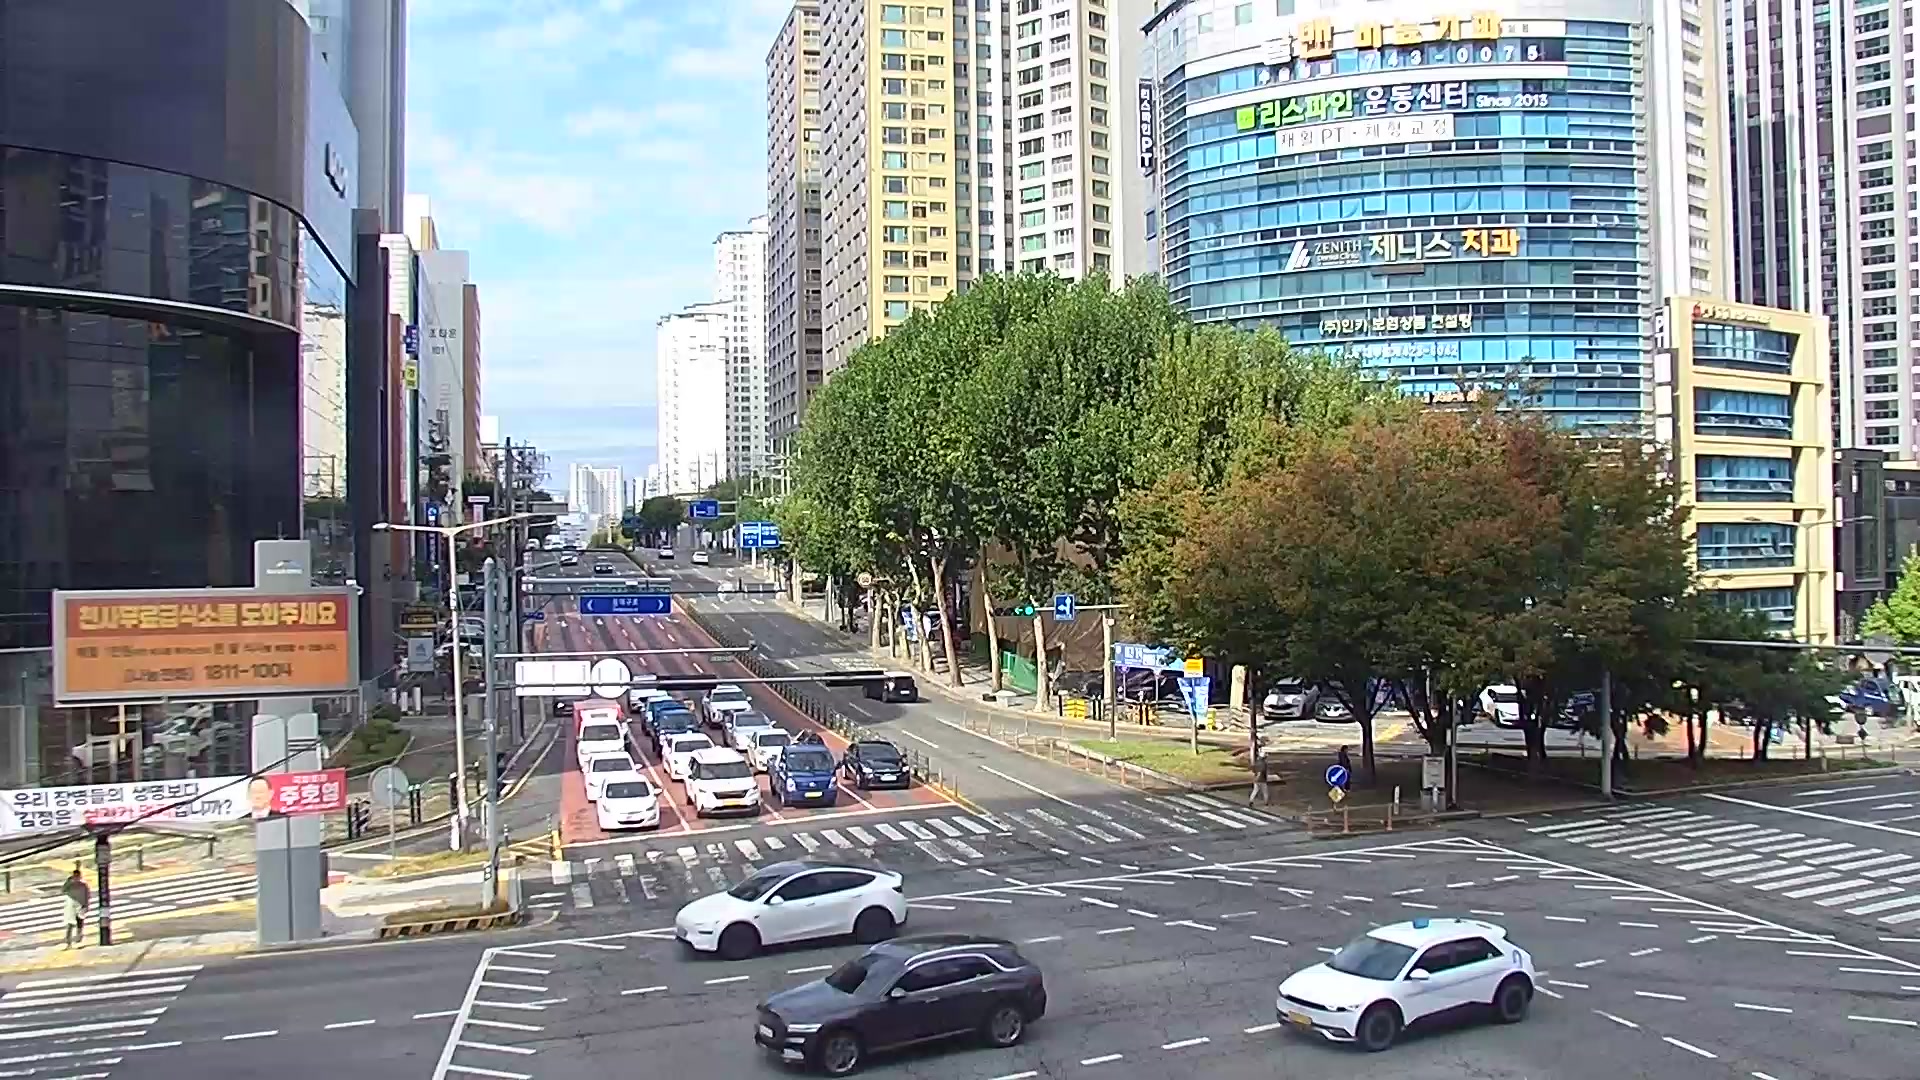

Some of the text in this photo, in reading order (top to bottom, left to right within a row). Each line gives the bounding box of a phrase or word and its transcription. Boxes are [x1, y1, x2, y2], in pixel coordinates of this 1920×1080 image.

[1363, 44, 1540, 73] 743-0075
[1259, 80, 1549, 127] 리스파인 운동센터 Since 2013
[1314, 239, 1362, 255] ZENITH
[1369, 228, 1520, 262] 제니스 치과
[241, 601, 337, 626] 도와주세요
[14, 791, 48, 808] 우리
